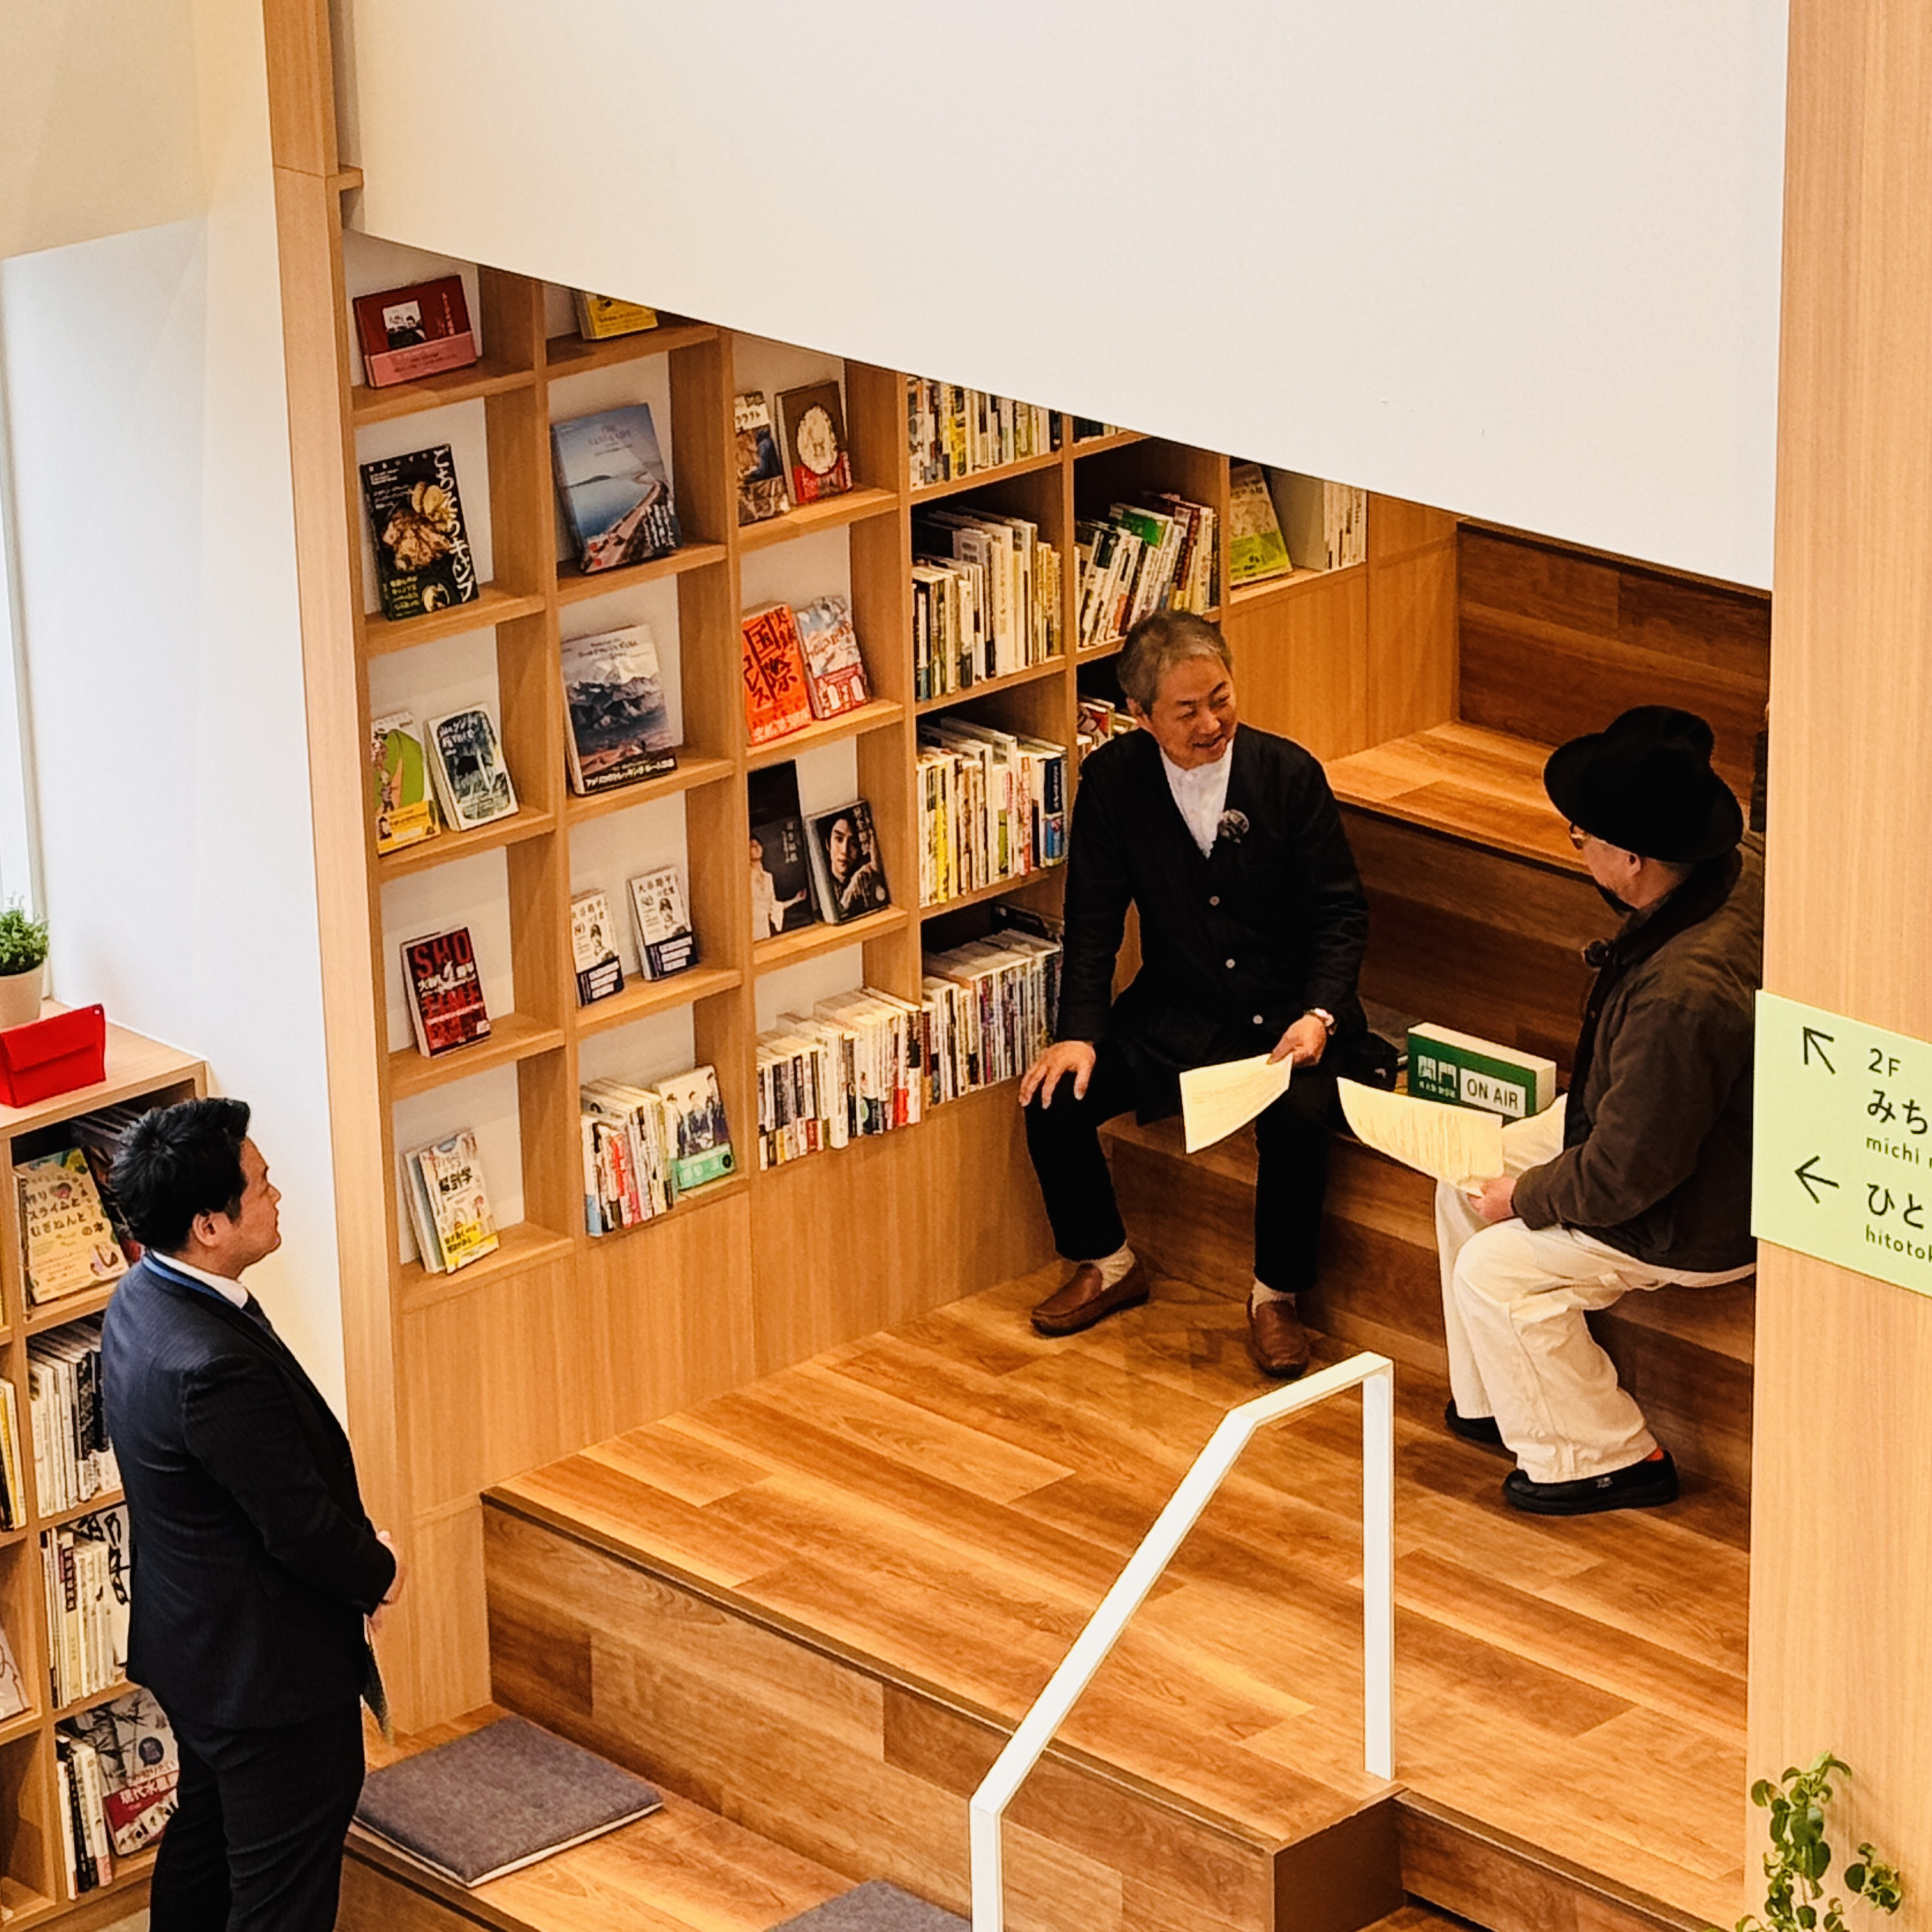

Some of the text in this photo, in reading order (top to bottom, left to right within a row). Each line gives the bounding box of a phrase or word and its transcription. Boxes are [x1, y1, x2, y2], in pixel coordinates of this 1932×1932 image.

[414, 931, 472, 979] SHO
[1868, 1047, 1901, 1077] 2F
[1467, 1078, 1489, 1100] ON
[1493, 1086, 1519, 1112] AIR
[1867, 1089, 1928, 1135] みち
[1866, 1137, 1919, 1165] michi
[1866, 1182, 1924, 1230] ひと
